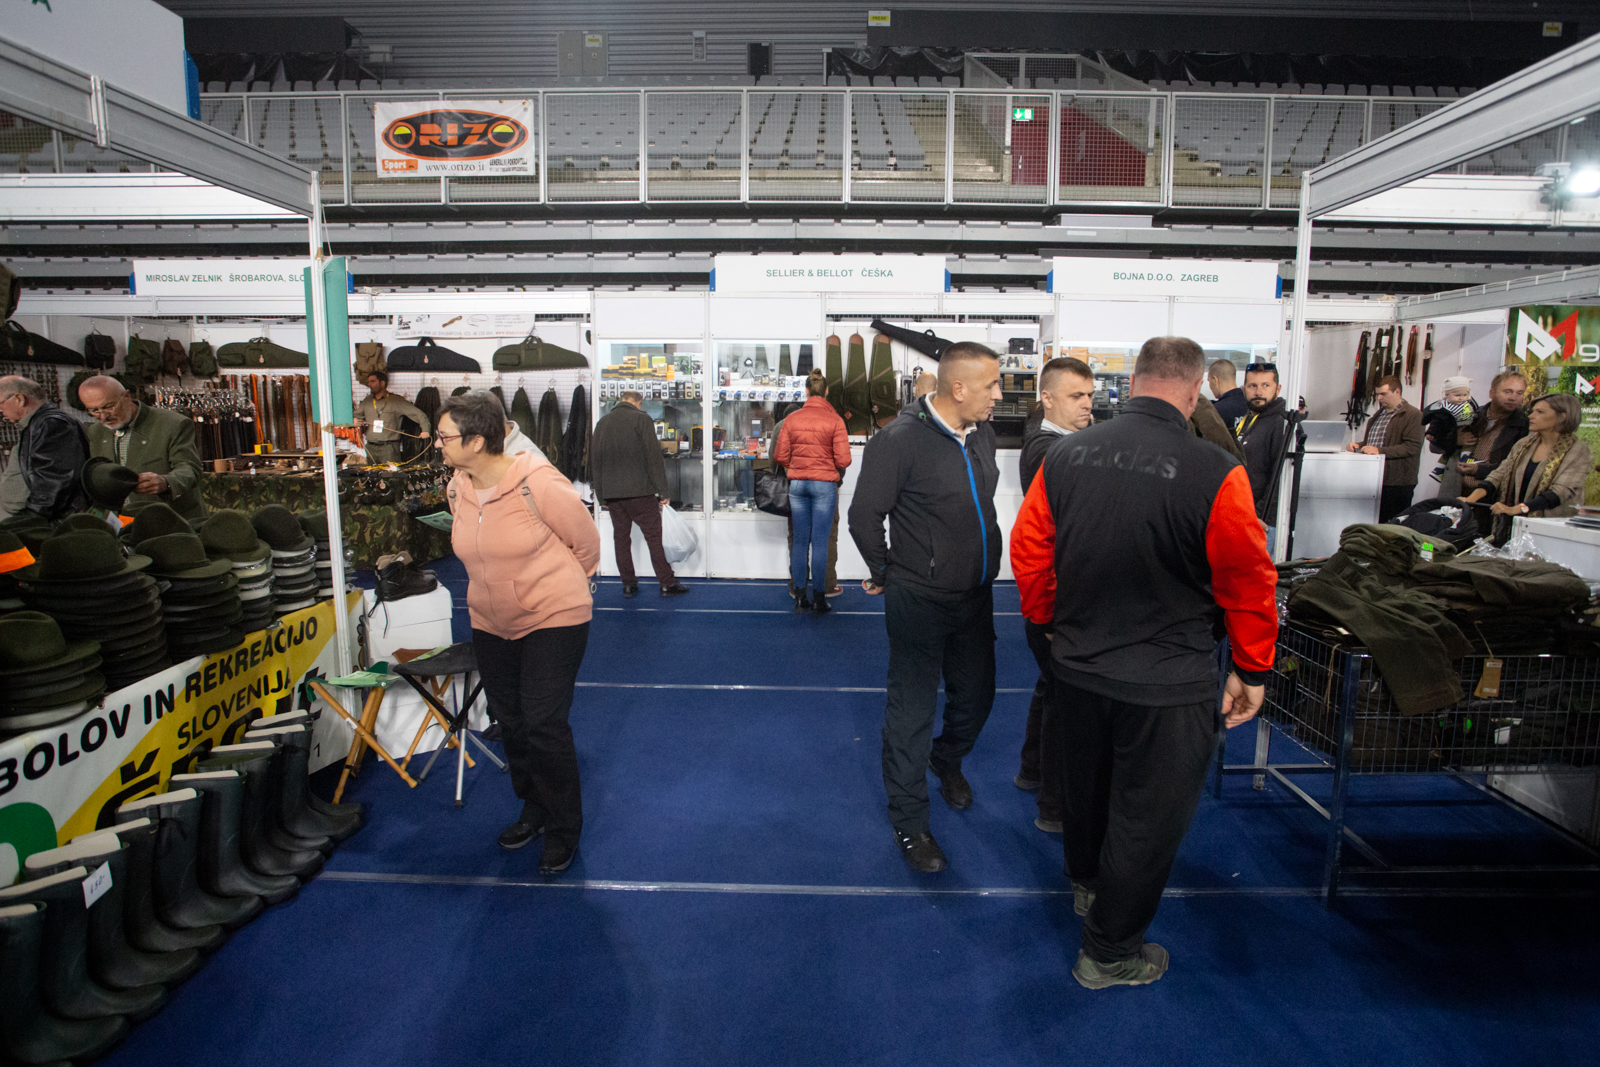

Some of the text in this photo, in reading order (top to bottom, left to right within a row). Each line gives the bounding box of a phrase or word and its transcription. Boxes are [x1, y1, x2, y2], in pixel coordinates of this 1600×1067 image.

[389, 120, 519, 148] ORIZO
[384, 159, 407, 170] Sport
[425, 162, 485, 172] www.orizo.it
[145, 274, 190, 282] MIROSLAV
[192, 274, 223, 282] ZELNIK
[229, 272, 287, 283] ŠROBAROVA,
[766, 267, 894, 277] SELLIER & BELLOT ČEŠKA
[1113, 272, 1219, 283] BOJNA D.O.O. ZAGREB
[1069, 441, 1179, 479] adidas
[143, 683, 175, 725] IN
[184, 616, 318, 703] REKREACIJO
